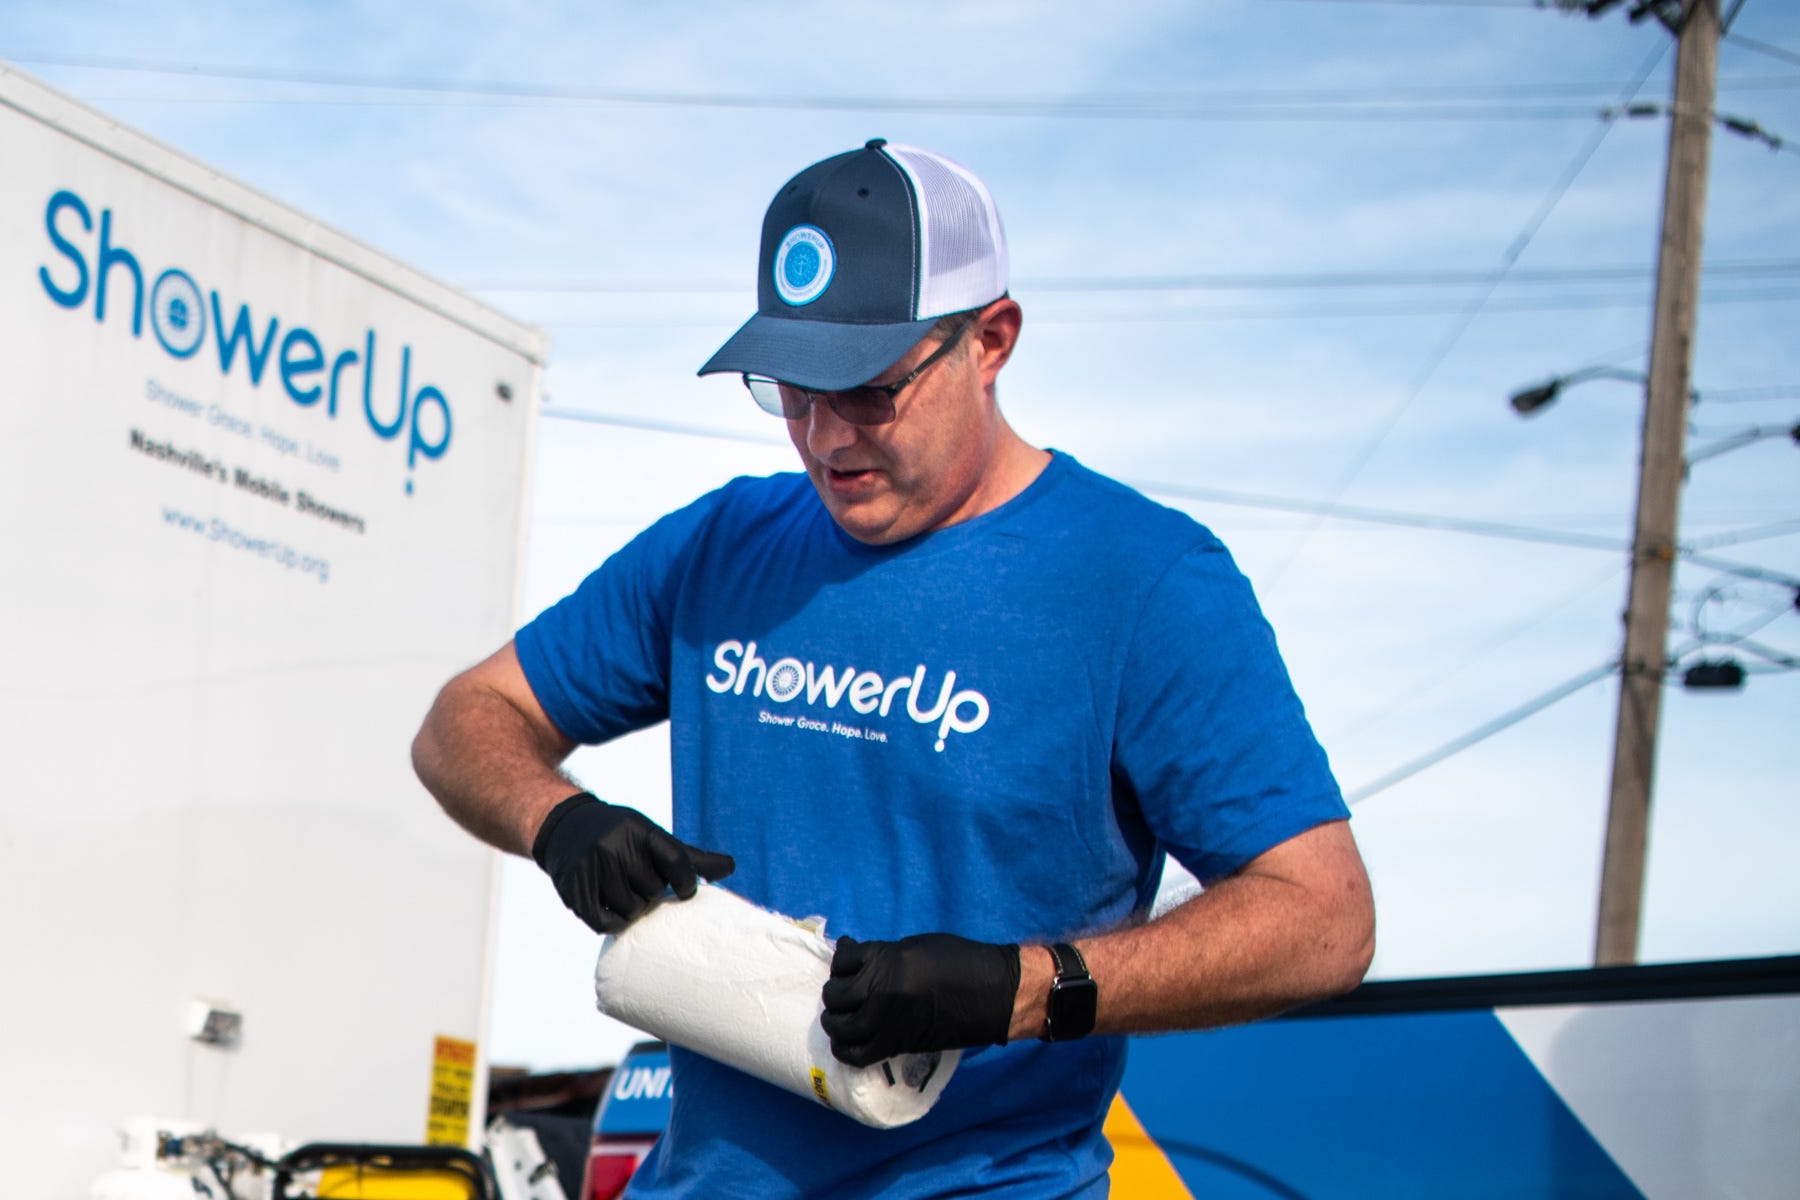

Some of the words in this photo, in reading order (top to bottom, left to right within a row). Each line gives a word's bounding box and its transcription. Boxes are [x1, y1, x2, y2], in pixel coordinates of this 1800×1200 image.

[39, 190, 453, 496] ShowerUp
[130, 428, 228, 484] Nashville's
[234, 466, 290, 506] Mobile
[296, 490, 366, 534] Showers
[705, 639, 990, 752] ShowerUp
[758, 711, 796, 727] Shower
[797, 716, 829, 733] Grace.
[831, 721, 863, 739] Hope.
[865, 728, 889, 744] Love.
[616, 1067, 674, 1100] UNI
